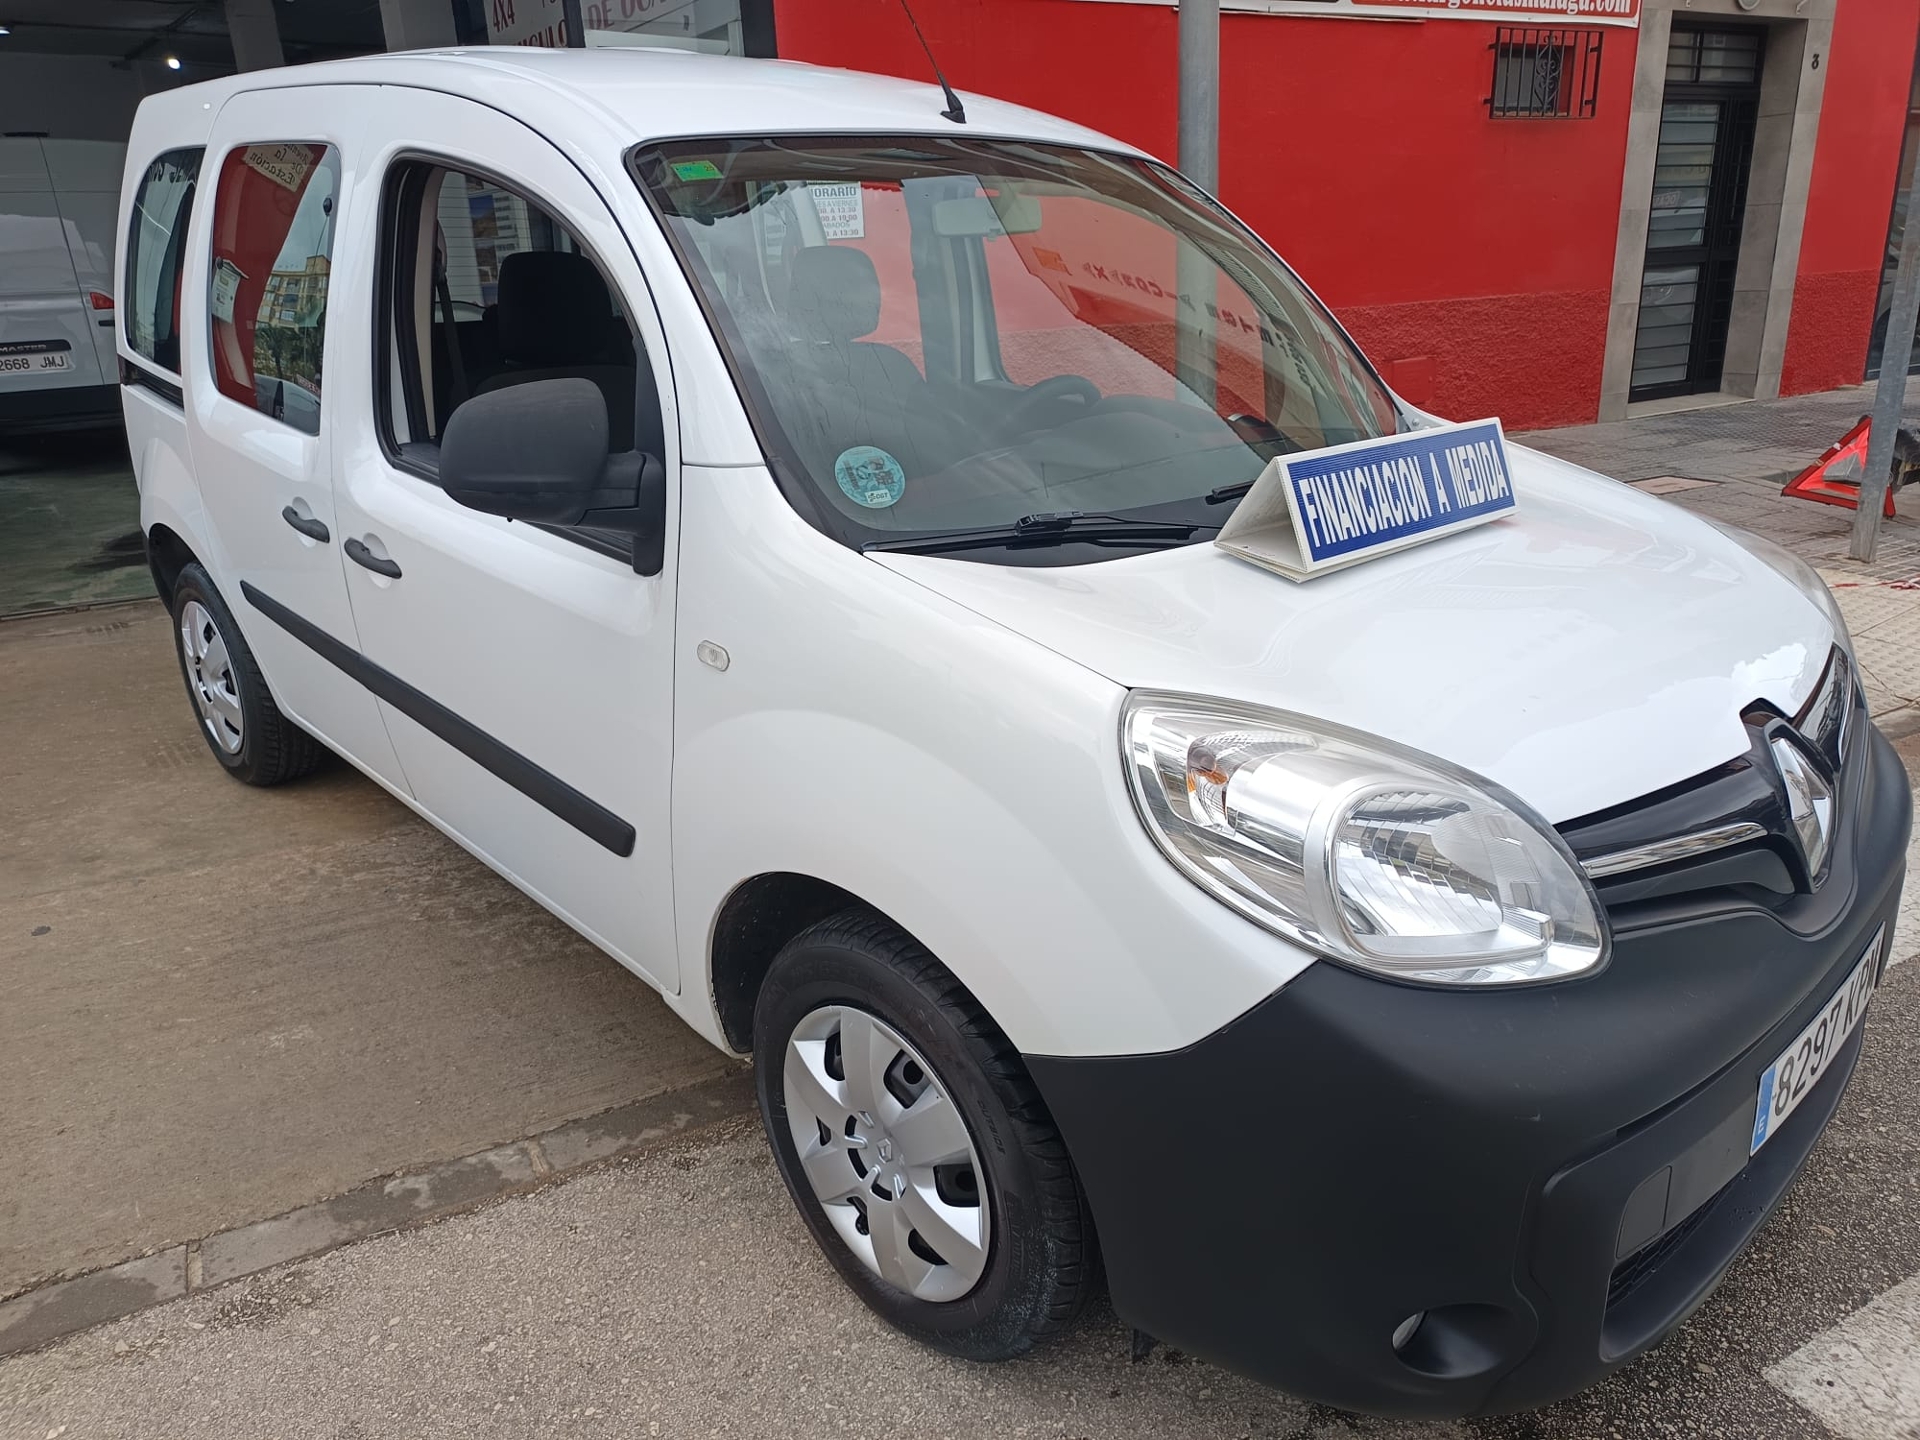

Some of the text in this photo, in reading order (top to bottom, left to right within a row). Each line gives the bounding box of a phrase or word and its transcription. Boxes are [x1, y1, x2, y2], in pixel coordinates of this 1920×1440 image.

[587, 0, 614, 29] DE
[1811, 53, 1820, 70] 3
[811, 187, 857, 197] ORARIO
[0, 356, 65, 371] 2668 JMJ
[1298, 440, 1510, 548] FINANCIACION A MEDIDA
[1774, 996, 1844, 1117] 8297
